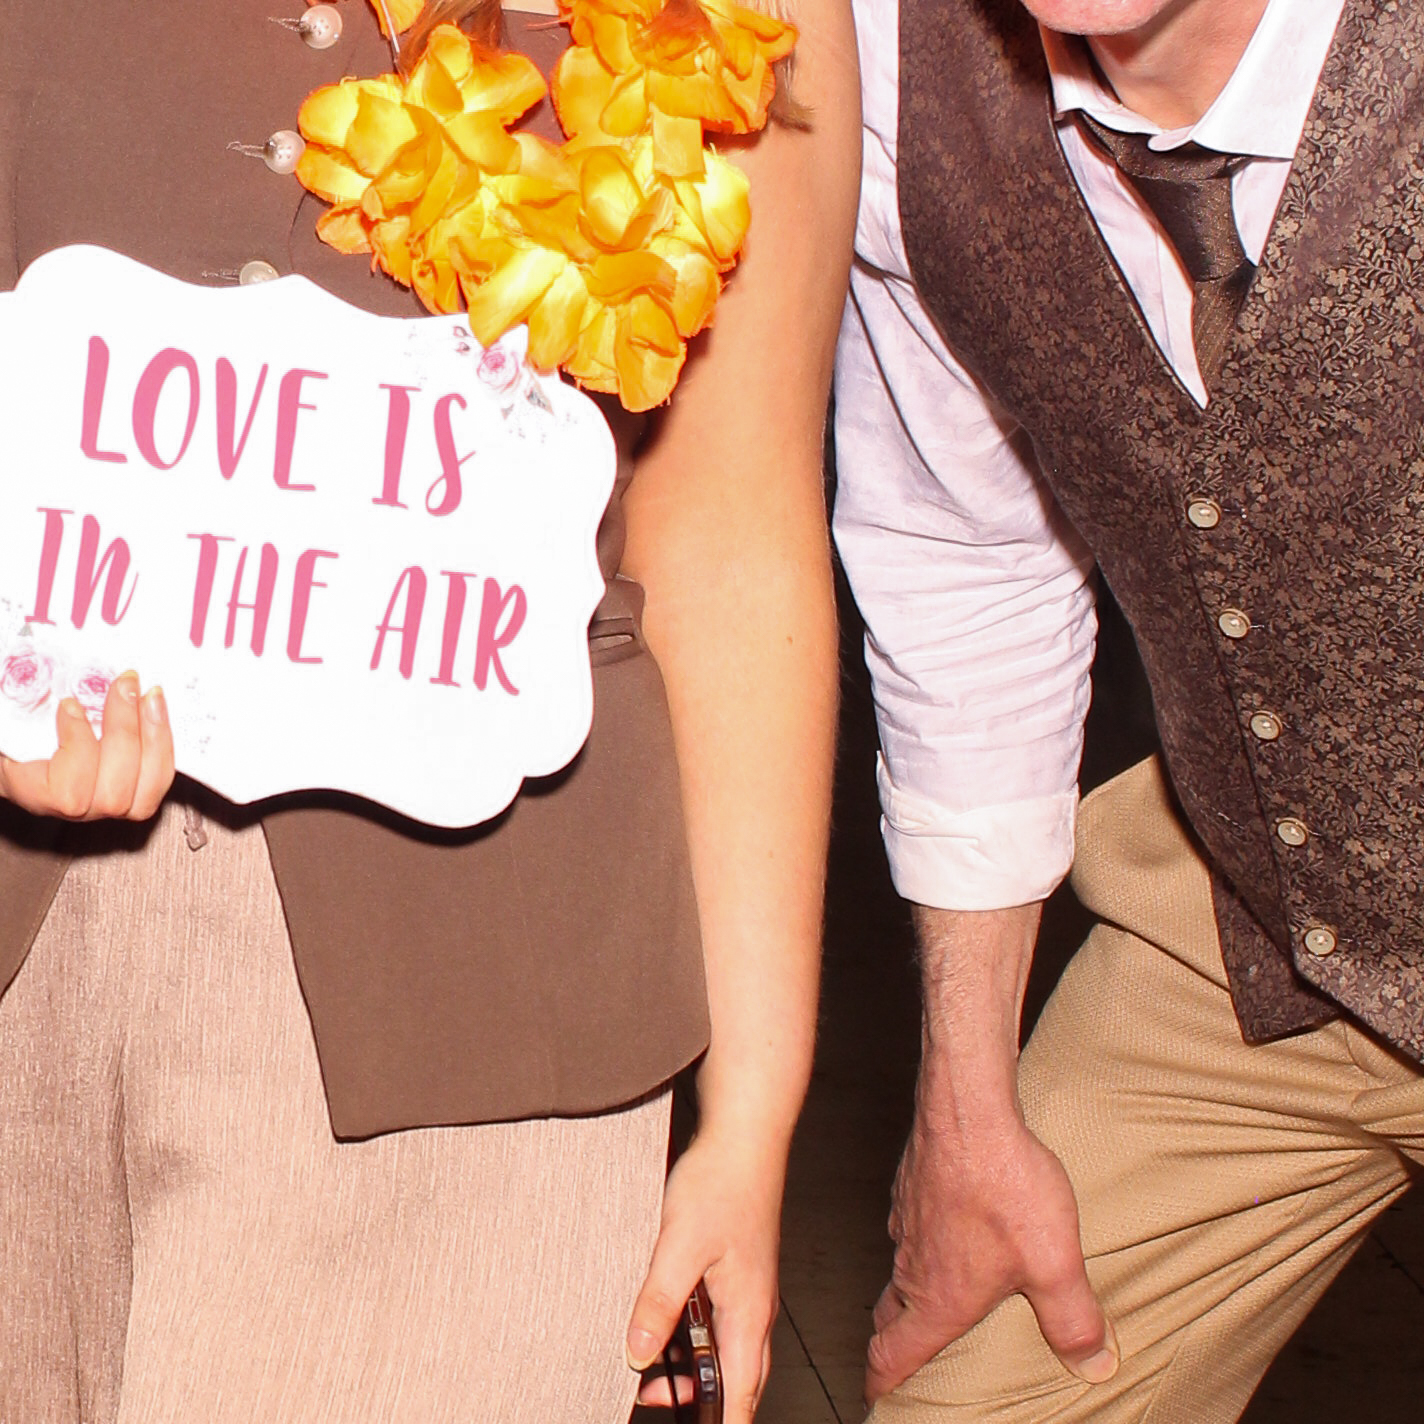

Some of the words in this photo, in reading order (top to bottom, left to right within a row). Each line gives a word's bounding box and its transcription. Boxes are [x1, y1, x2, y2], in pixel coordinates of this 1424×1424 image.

[79, 334, 329, 491] LOVE
[371, 382, 477, 517] IS
[187, 532, 340, 665] THE
[369, 564, 528, 696] AIR
